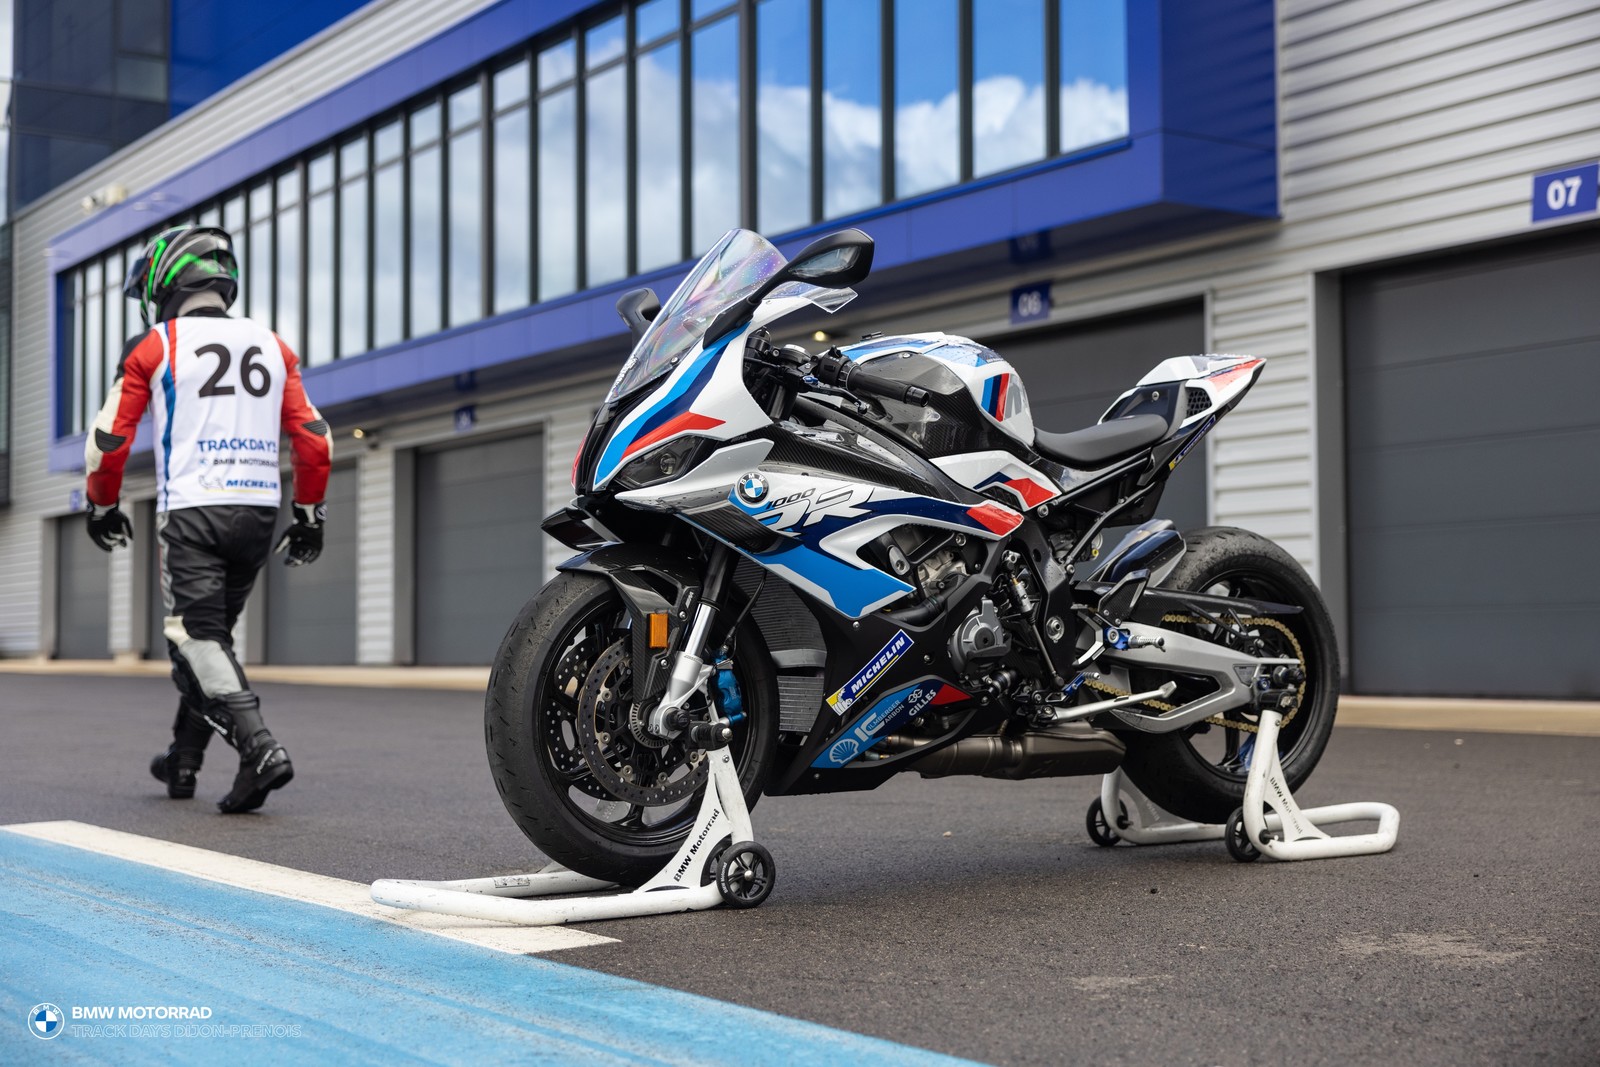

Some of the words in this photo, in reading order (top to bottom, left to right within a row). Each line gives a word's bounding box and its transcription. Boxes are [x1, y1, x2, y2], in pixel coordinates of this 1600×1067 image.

[1546, 175, 1582, 211] 07
[194, 343, 271, 398] 26
[766, 487, 816, 510] 1000
[850, 636, 906, 694] MICHELIN
[908, 689, 937, 717] GILLES
[674, 855, 693, 882] BMW
[690, 808, 720, 855] Motorrad
